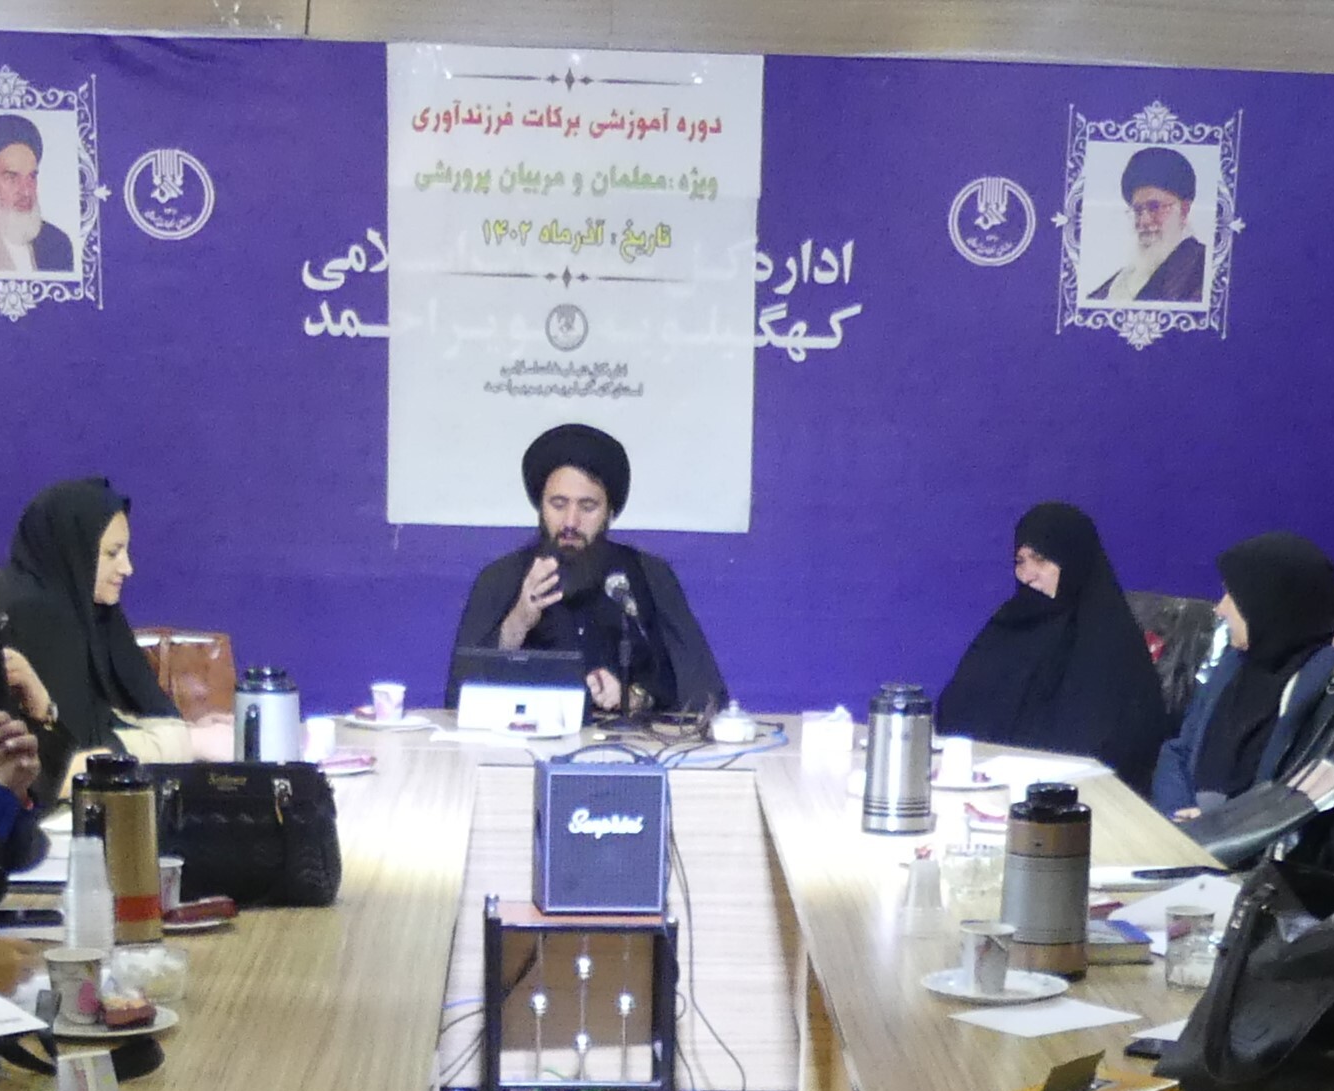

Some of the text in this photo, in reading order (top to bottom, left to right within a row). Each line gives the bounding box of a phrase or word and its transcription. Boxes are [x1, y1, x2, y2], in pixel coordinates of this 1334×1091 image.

[411, 99, 723, 142] دوره آموزشی برکات فرزندآوری
[414, 159, 492, 194] پرورشی
[498, 161, 565, 195] مربیان
[571, 173, 584, 197] و
[537, 216, 606, 253] آذرماه
[619, 219, 673, 263] تاریخ
